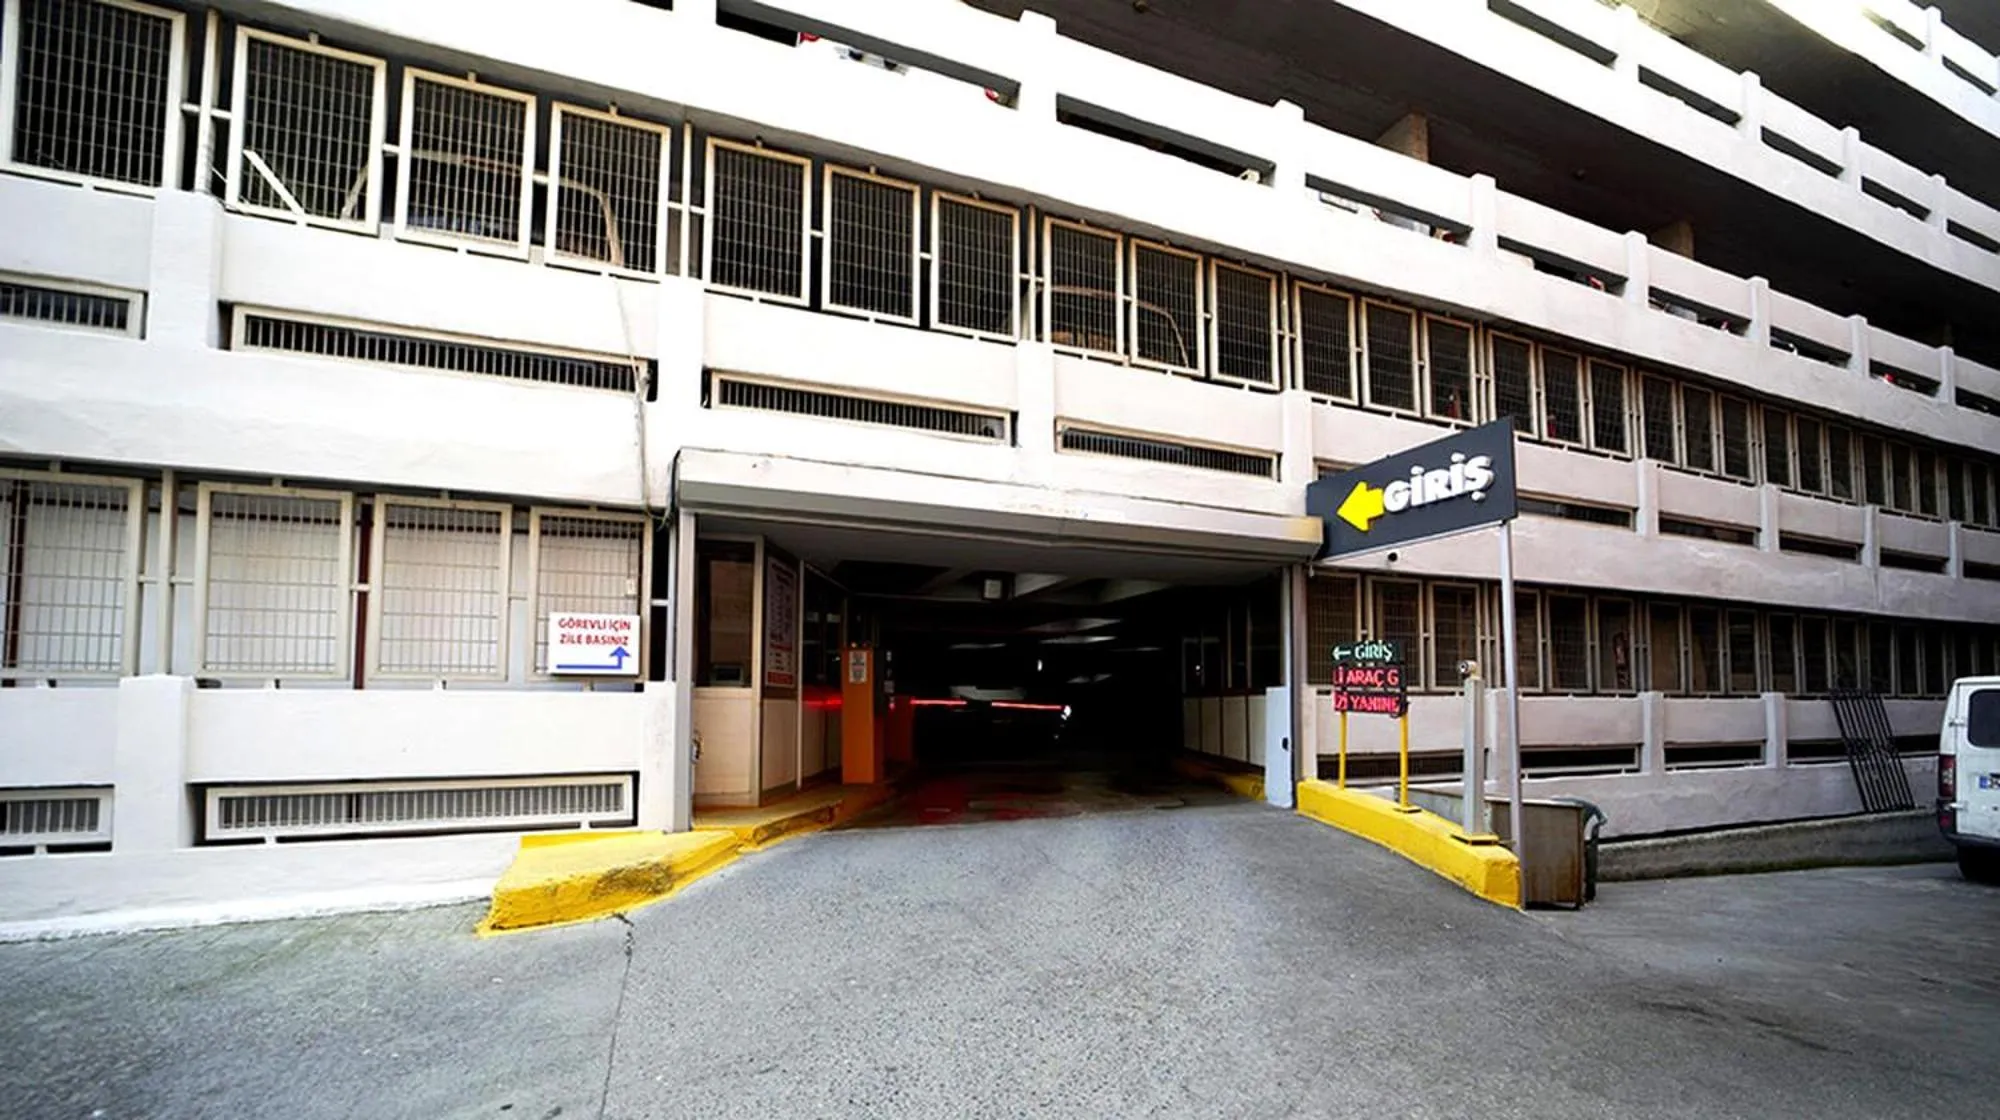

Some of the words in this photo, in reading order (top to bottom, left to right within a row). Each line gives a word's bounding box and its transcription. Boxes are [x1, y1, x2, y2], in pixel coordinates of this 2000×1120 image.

[1383, 452, 1494, 512] GİRİŞ
[559, 633, 583, 645] ZİLE
[1354, 640, 1393, 662] GİRİŞ
[1346, 669, 1385, 688] ARAÇ
